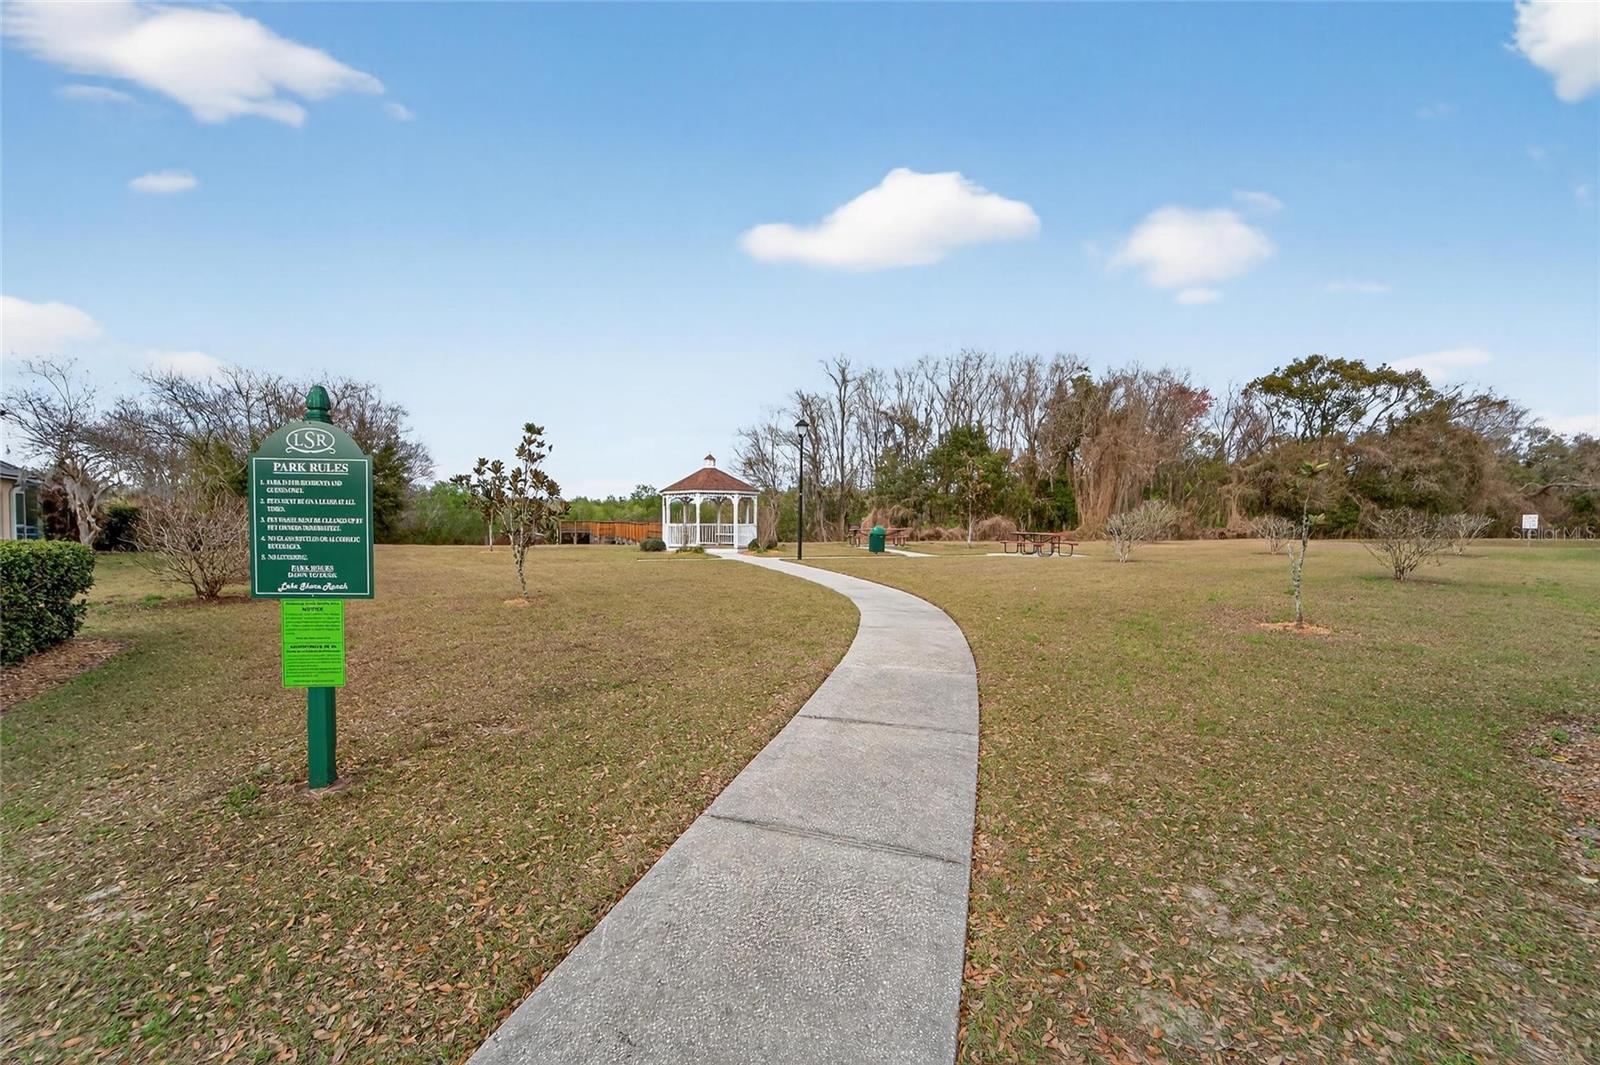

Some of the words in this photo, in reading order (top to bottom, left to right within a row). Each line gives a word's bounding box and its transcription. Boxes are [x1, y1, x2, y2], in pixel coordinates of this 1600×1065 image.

[294, 431, 328, 449] LSR
[273, 462, 306, 472] PARK
[309, 463, 349, 473] RULES
